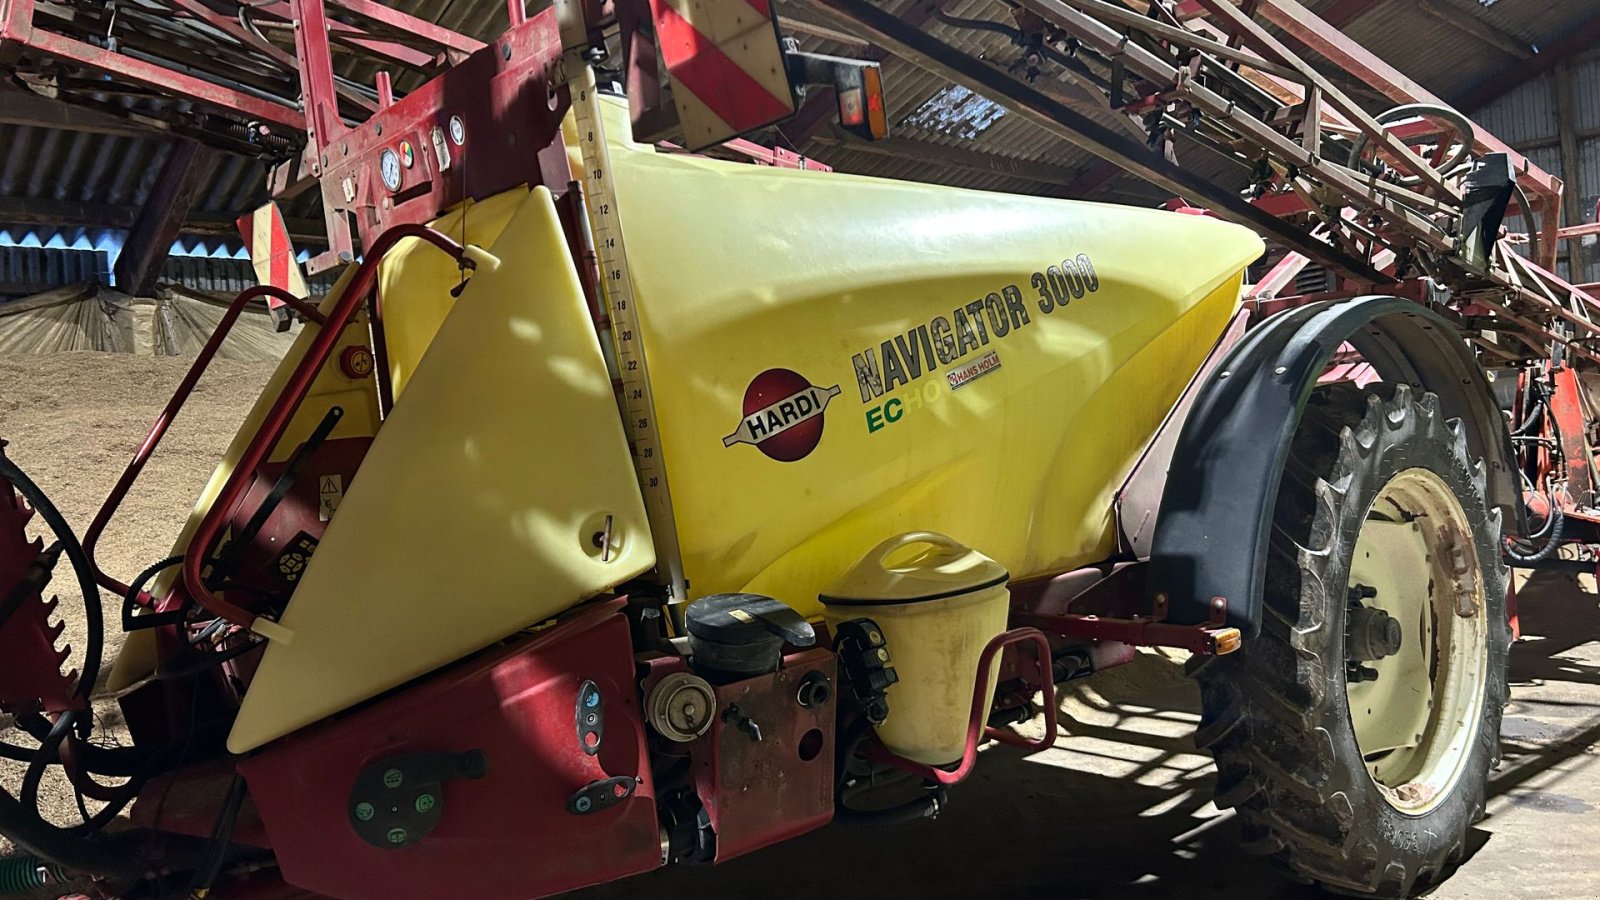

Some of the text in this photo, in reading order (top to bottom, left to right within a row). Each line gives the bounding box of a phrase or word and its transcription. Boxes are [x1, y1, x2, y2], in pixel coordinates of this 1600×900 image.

[580, 91, 586, 101] 6
[587, 132, 593, 142] 8
[593, 169, 602, 180] 10
[599, 204, 609, 215] 12
[605, 238, 615, 249] 14
[611, 270, 621, 280] 16
[617, 300, 626, 311] 18
[852, 253, 1099, 403] NAVIGATOR 3000
[622, 331, 632, 341] 20
[628, 360, 637, 371] 22
[957, 365, 978, 382] HANS
[978, 354, 1000, 371] HOLM
[633, 389, 642, 400] 24
[865, 379, 941, 434] ECHO
[747, 390, 821, 440] HARDI
[638, 418, 648, 429] 26
[643, 447, 653, 458] 28
[649, 476, 659, 487] 30
